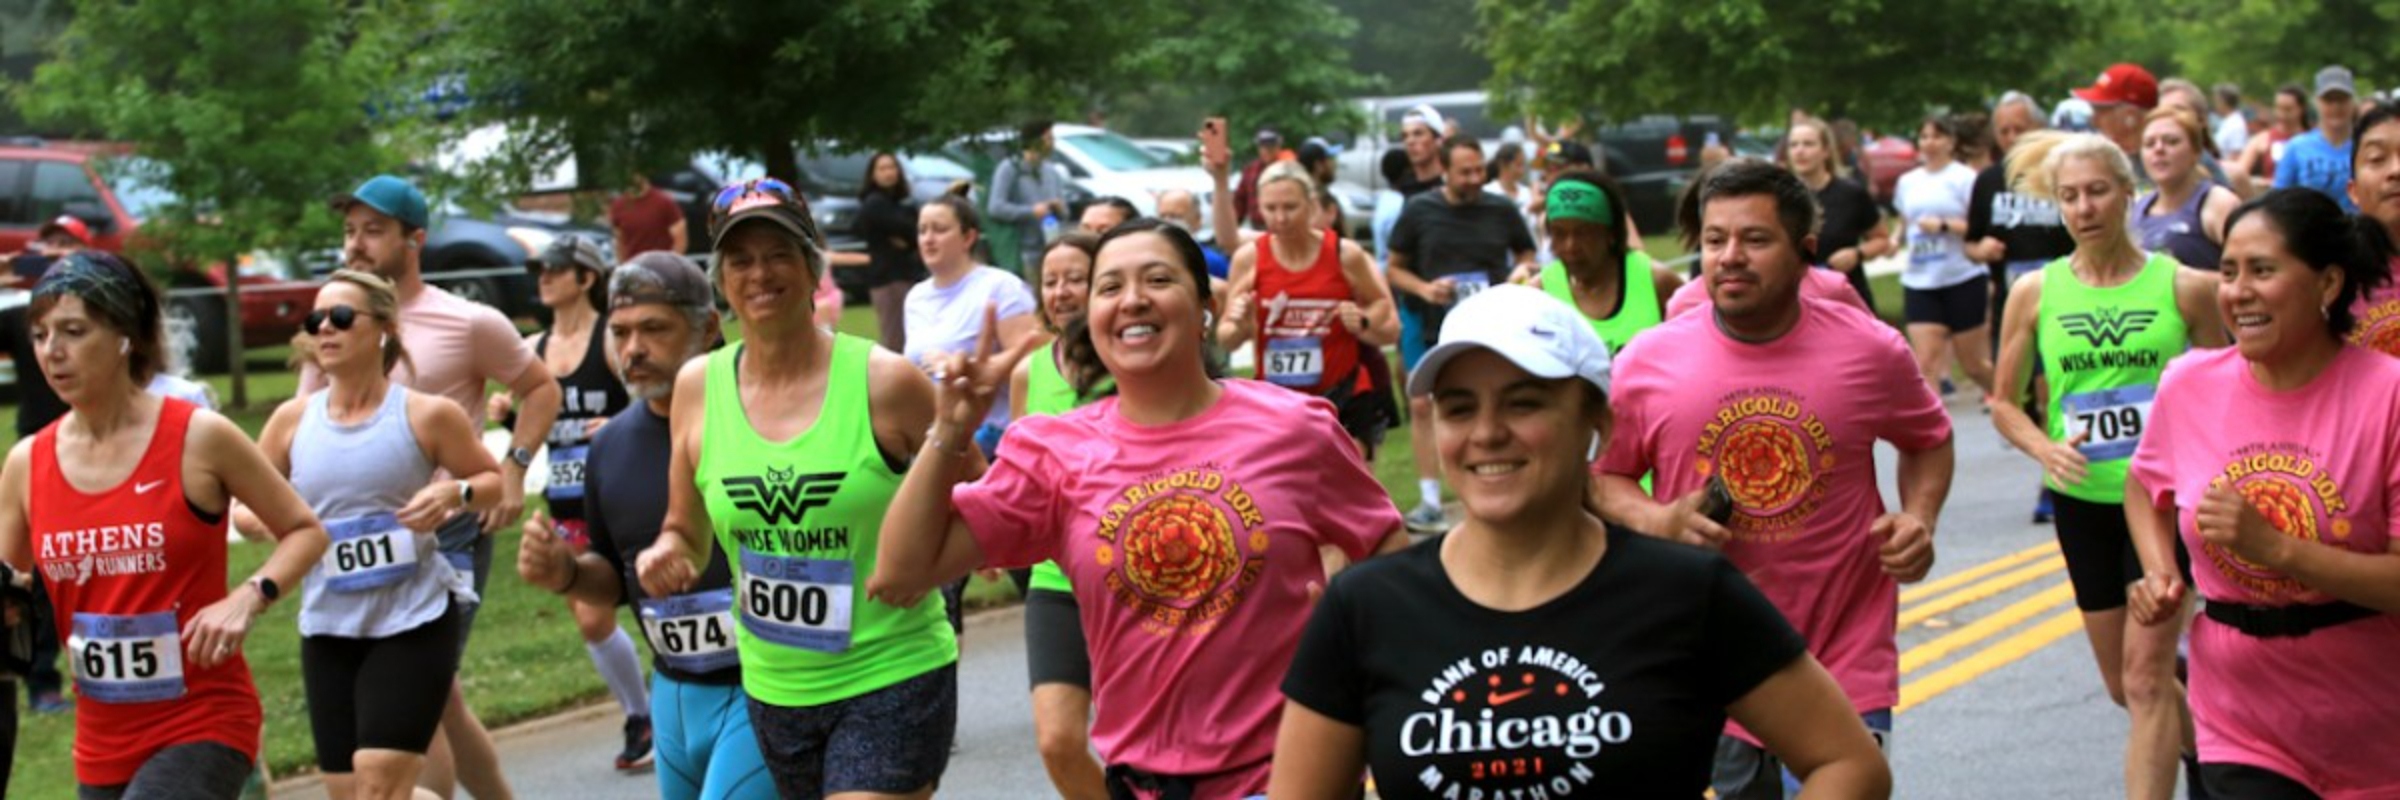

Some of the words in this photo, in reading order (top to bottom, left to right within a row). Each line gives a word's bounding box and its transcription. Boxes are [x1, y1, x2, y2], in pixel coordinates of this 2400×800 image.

[1271, 351, 1311, 373] 677
[2059, 352, 2096, 373] WISE
[2101, 349, 2159, 370] WOMEN
[1697, 396, 1801, 456] MARIGOLD
[1800, 413, 1833, 451] 10K
[2077, 406, 2142, 443] 709
[551, 461, 585, 485] 552
[2209, 452, 2314, 491] RIGOLD
[2310, 470, 2347, 517] 10K
[1097, 470, 1222, 545] MARIGOLD
[1223, 483, 1265, 531] 10K
[40, 521, 166, 559] ATHENS
[336, 533, 395, 572] 601
[777, 525, 848, 552] WOMEN
[95, 551, 168, 577] RUNNERS
[750, 579, 828, 626] 600
[660, 615, 727, 653] 674
[83, 640, 159, 679] 615
[1421, 656, 1478, 705] BANK
[1481, 647, 1510, 668] OF
[1518, 645, 1605, 699] AMERICA
[1401, 705, 1634, 759] Chicago
[1417, 761, 1595, 800] MARATHON
[1471, 755, 1543, 778] 2021
